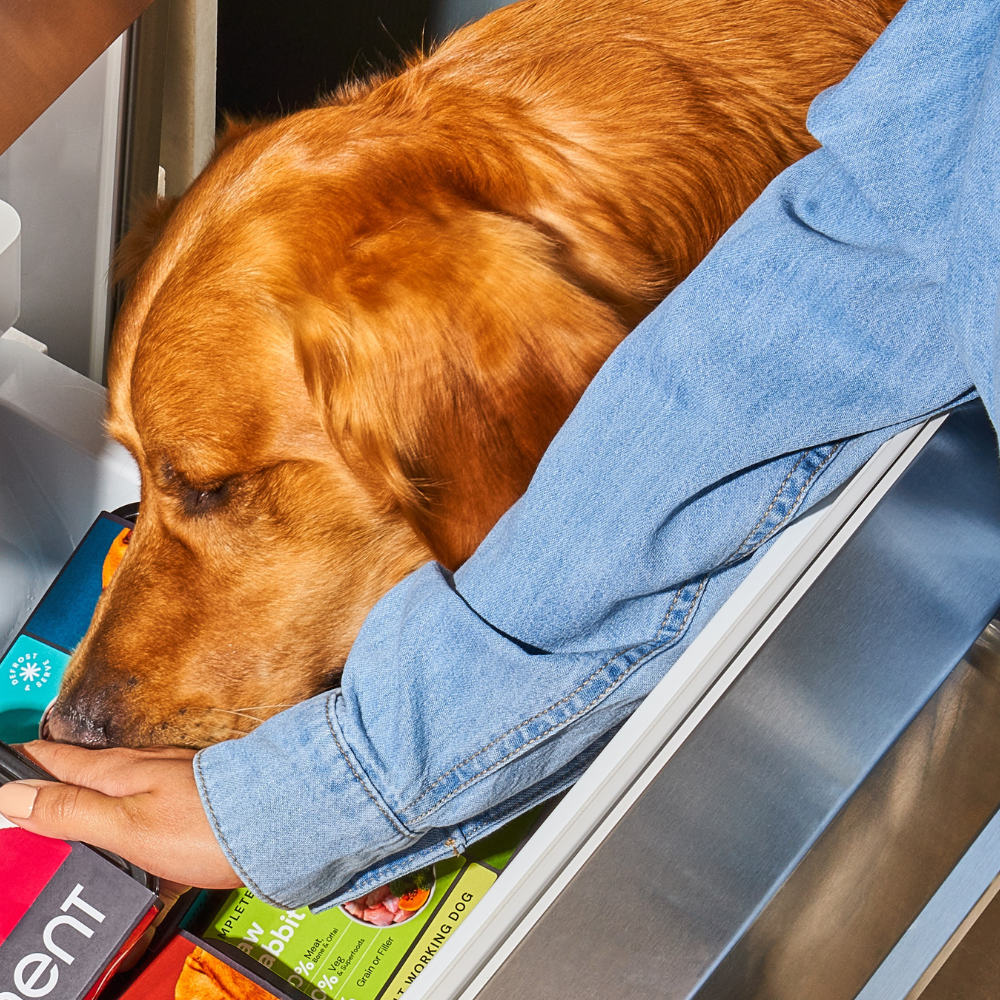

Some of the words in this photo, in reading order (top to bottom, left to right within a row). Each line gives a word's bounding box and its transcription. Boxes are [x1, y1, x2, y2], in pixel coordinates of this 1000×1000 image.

[9, 653, 38, 686] DEFROST
[36, 659, 51, 688] SERVE
[217, 890, 255, 940] MPLETE
[236, 921, 264, 956] aw
[259, 909, 306, 970] abbit
[304, 938, 324, 959] Meat,
[341, 938, 365, 970] Superfoods
[405, 924, 452, 985] WORKING
[448, 892, 474, 922] DOG
[328, 956, 345, 972] Veg
[356, 965, 375, 987] Grain
[372, 955, 381, 966] or
[377, 937, 394, 956] Filler
